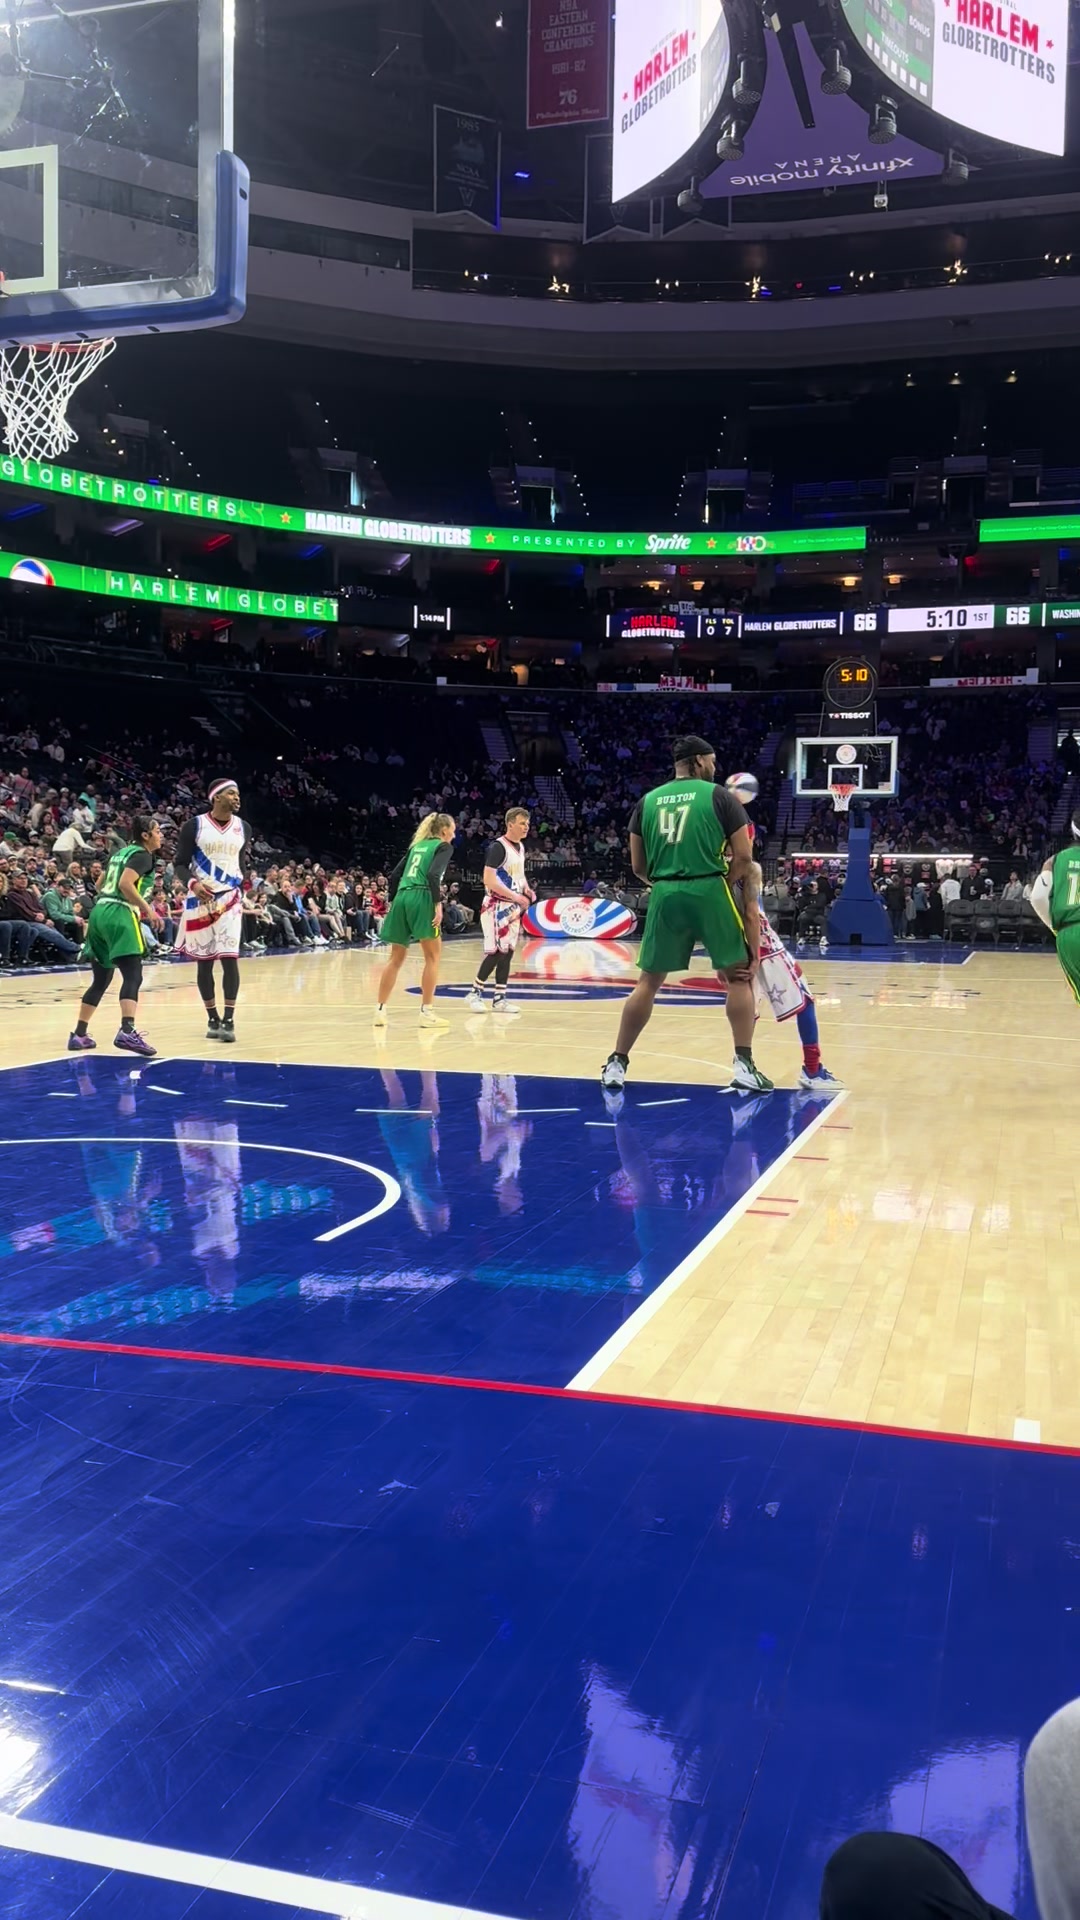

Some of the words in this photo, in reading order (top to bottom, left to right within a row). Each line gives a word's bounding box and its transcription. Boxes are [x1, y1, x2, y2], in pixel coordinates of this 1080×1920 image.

[549, 9, 588, 26] EASTERN
[908, 15, 931, 38] BONUS
[956, 0, 1039, 54] HARLEM
[541, 22, 597, 40] CONFERENCE
[543, 35, 594, 53] CHAMPIONS
[881, 31, 909, 64] TIMEOUTS
[942, 21, 1055, 84] GLOBETROTTERS
[633, 29, 689, 101] HARLEM
[559, 88, 578, 105] 76
[621, 53, 697, 134] GLOBETROTTERS
[774, 152, 861, 169] ARENA
[826, 157, 915, 176] xfinity
[730, 169, 819, 187] mobile
[2, 460, 237, 516] GLOBETROTTERS
[305, 511, 363, 536] HARLEM
[364, 518, 472, 546] GLOBETROTTERS
[512, 535, 606, 548] PRESENTED
[616, 539, 635, 548] BY
[645, 533, 692, 553] Sprite
[110, 576, 220, 604] HARLEM
[631, 614, 677, 629] HARLEM
[853, 613, 877, 632] 66
[926, 609, 968, 628] 5:10
[973, 612, 988, 622] 1ST
[1006, 606, 1031, 625] 66
[621, 627, 686, 639] GLOBETROTTERS
[706, 626, 715, 636] 0
[724, 626, 732, 636] 7
[744, 621, 772, 632] HARLEM
[773, 619, 837, 632] GLOBETROTTERS
[841, 669, 868, 681] 5:10
[839, 711, 871, 720] TISSOT
[656, 791, 697, 805] BURTON
[659, 804, 690, 843] 47
[406, 853, 422, 878] 2
